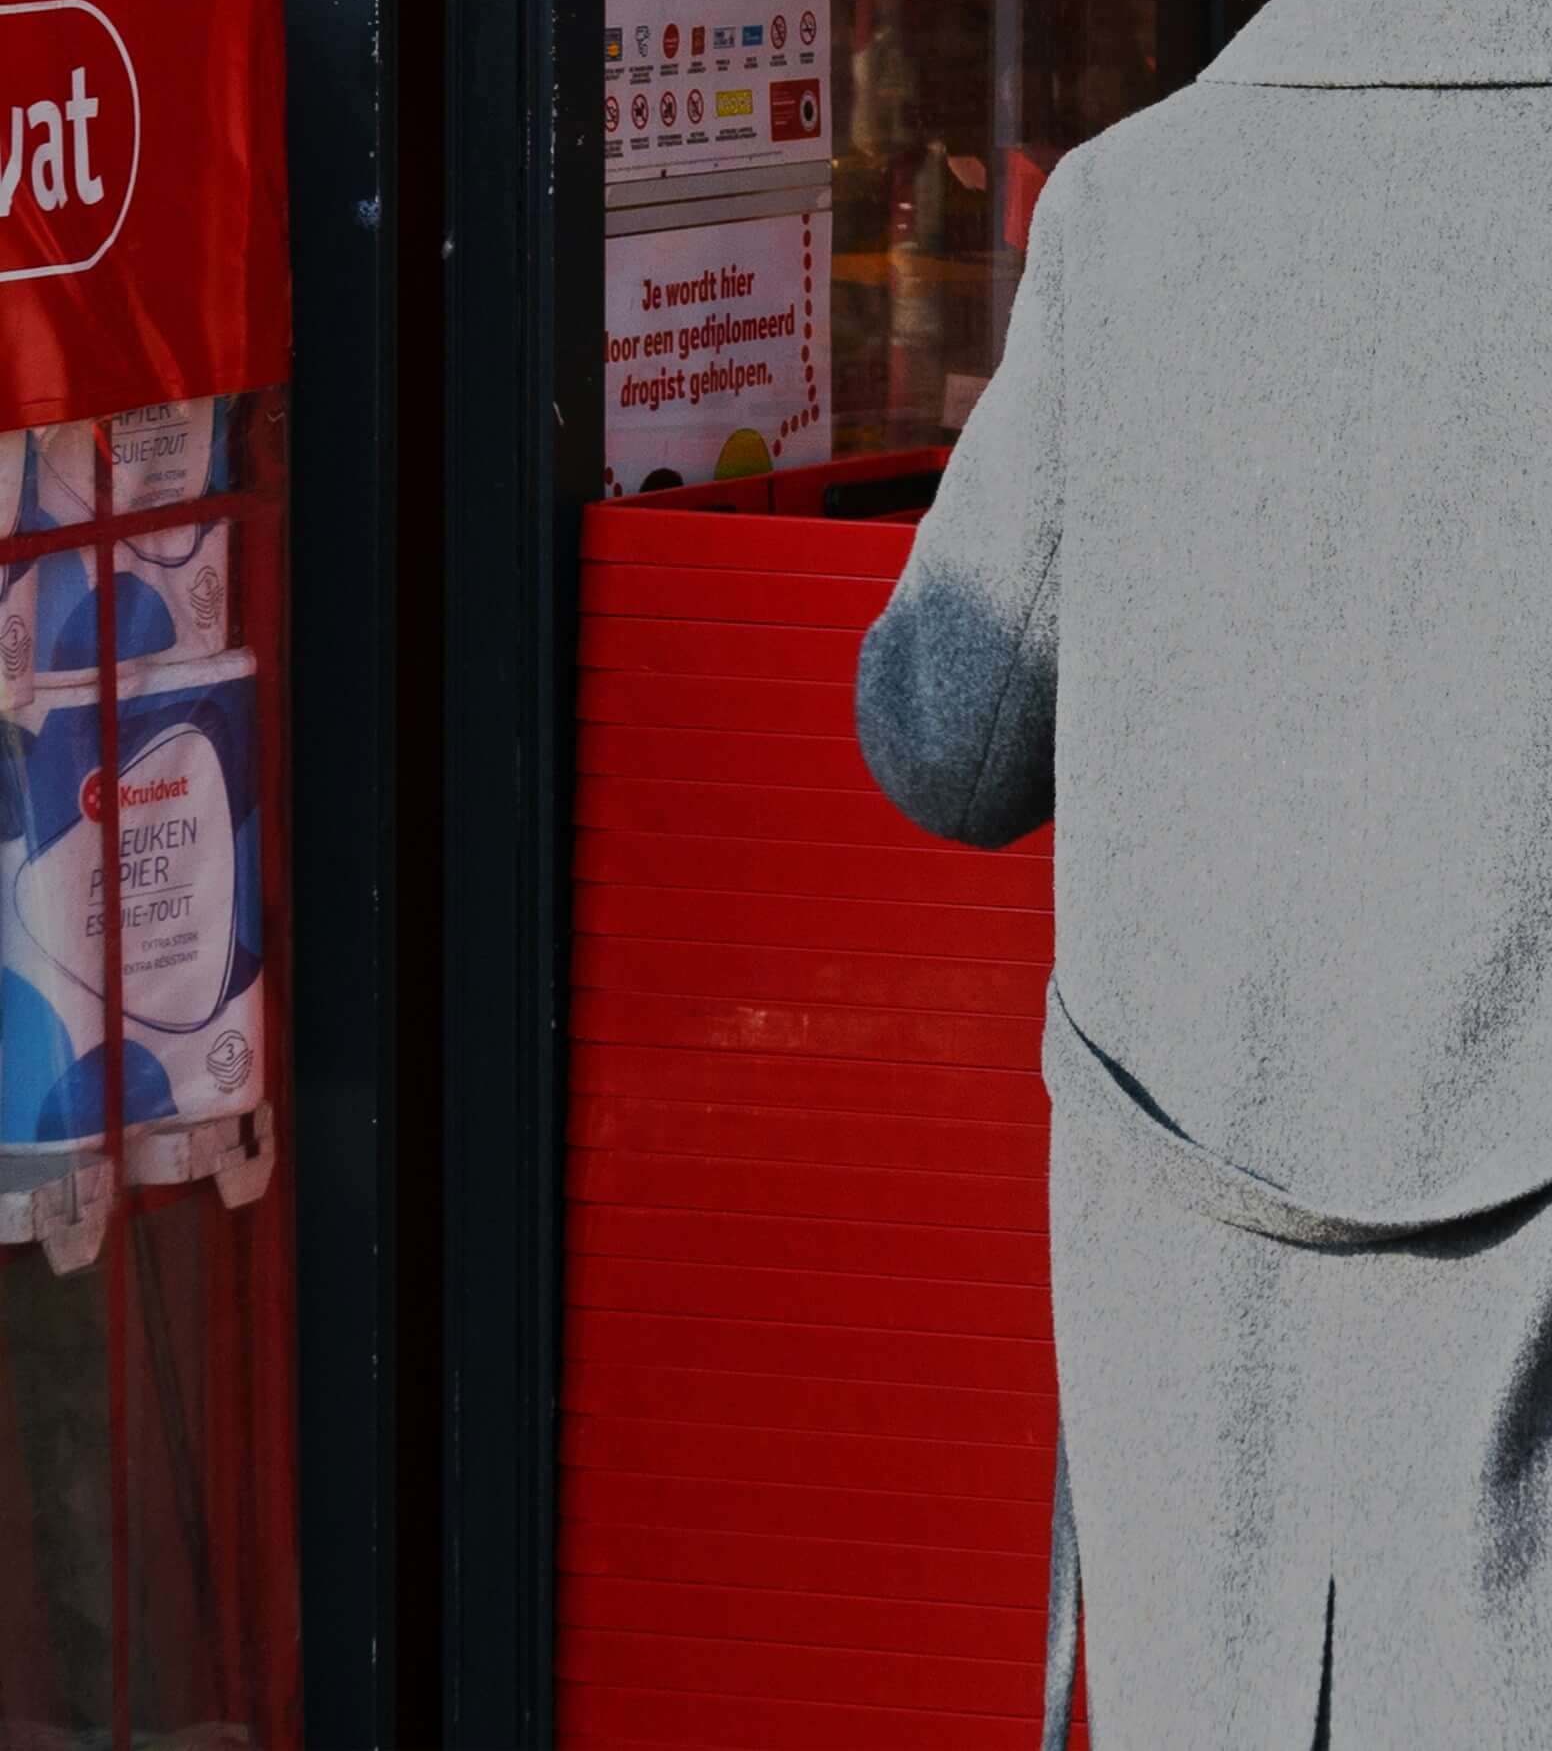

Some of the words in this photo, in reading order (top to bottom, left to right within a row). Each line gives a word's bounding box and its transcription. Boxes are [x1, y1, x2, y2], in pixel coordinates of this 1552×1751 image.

[642, 279, 662, 312] Je
[666, 269, 716, 308] wordt
[721, 264, 755, 299] hier
[644, 328, 673, 360] een
[678, 304, 795, 360] gediplomeerd
[621, 367, 685, 411] drogist
[690, 358, 773, 405] geholpen.
[119, 777, 188, 808] Kruidvat
[120, 817, 197, 858] EUKEN
[90, 856, 169, 898] PPIER
